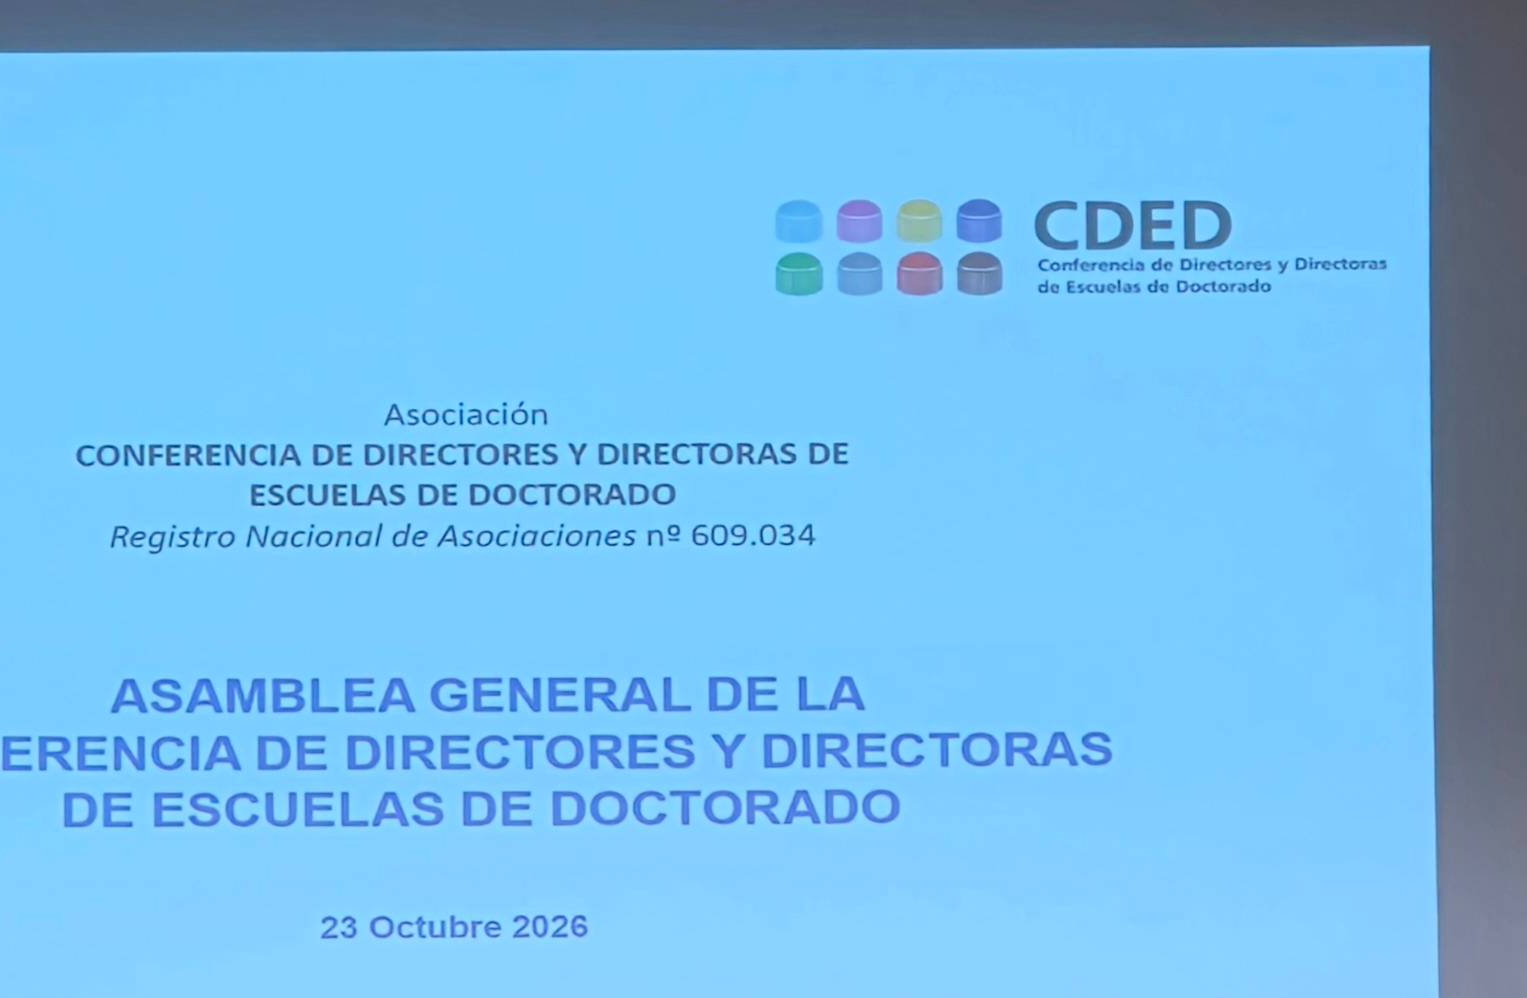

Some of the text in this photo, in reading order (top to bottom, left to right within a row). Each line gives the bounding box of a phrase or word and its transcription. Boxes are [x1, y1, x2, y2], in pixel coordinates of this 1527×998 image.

[1033, 199, 1233, 251] CDED
[1037, 256, 1388, 275] Conferencia de Directores y Directoras
[1037, 277, 1273, 295] de Escuelas de Doctorado
[383, 400, 548, 427] Asociación
[75, 441, 849, 468] CONFERENCIA DE DIRECTORES Y DIRECTORAS DE
[250, 482, 677, 507] ESCUELAS DE DOCTORADO
[110, 524, 236, 555] Registro
[245, 522, 384, 549] Nacional
[391, 522, 429, 548] de
[436, 522, 637, 548] Asociaciones
[691, 523, 817, 547] 609.034
[109, 675, 867, 715] ASAMBLEA GENERAL DE LA
[256, 734, 328, 772] DE
[346, 733, 696, 771] DIRECTORES
[710, 733, 747, 770] Y
[762, 730, 1113, 769] DIRECTORAS
[63, 788, 901, 829] DE ESCUELAS DE DOCTORADO
[320, 914, 589, 940] 23 Octubre 2026
